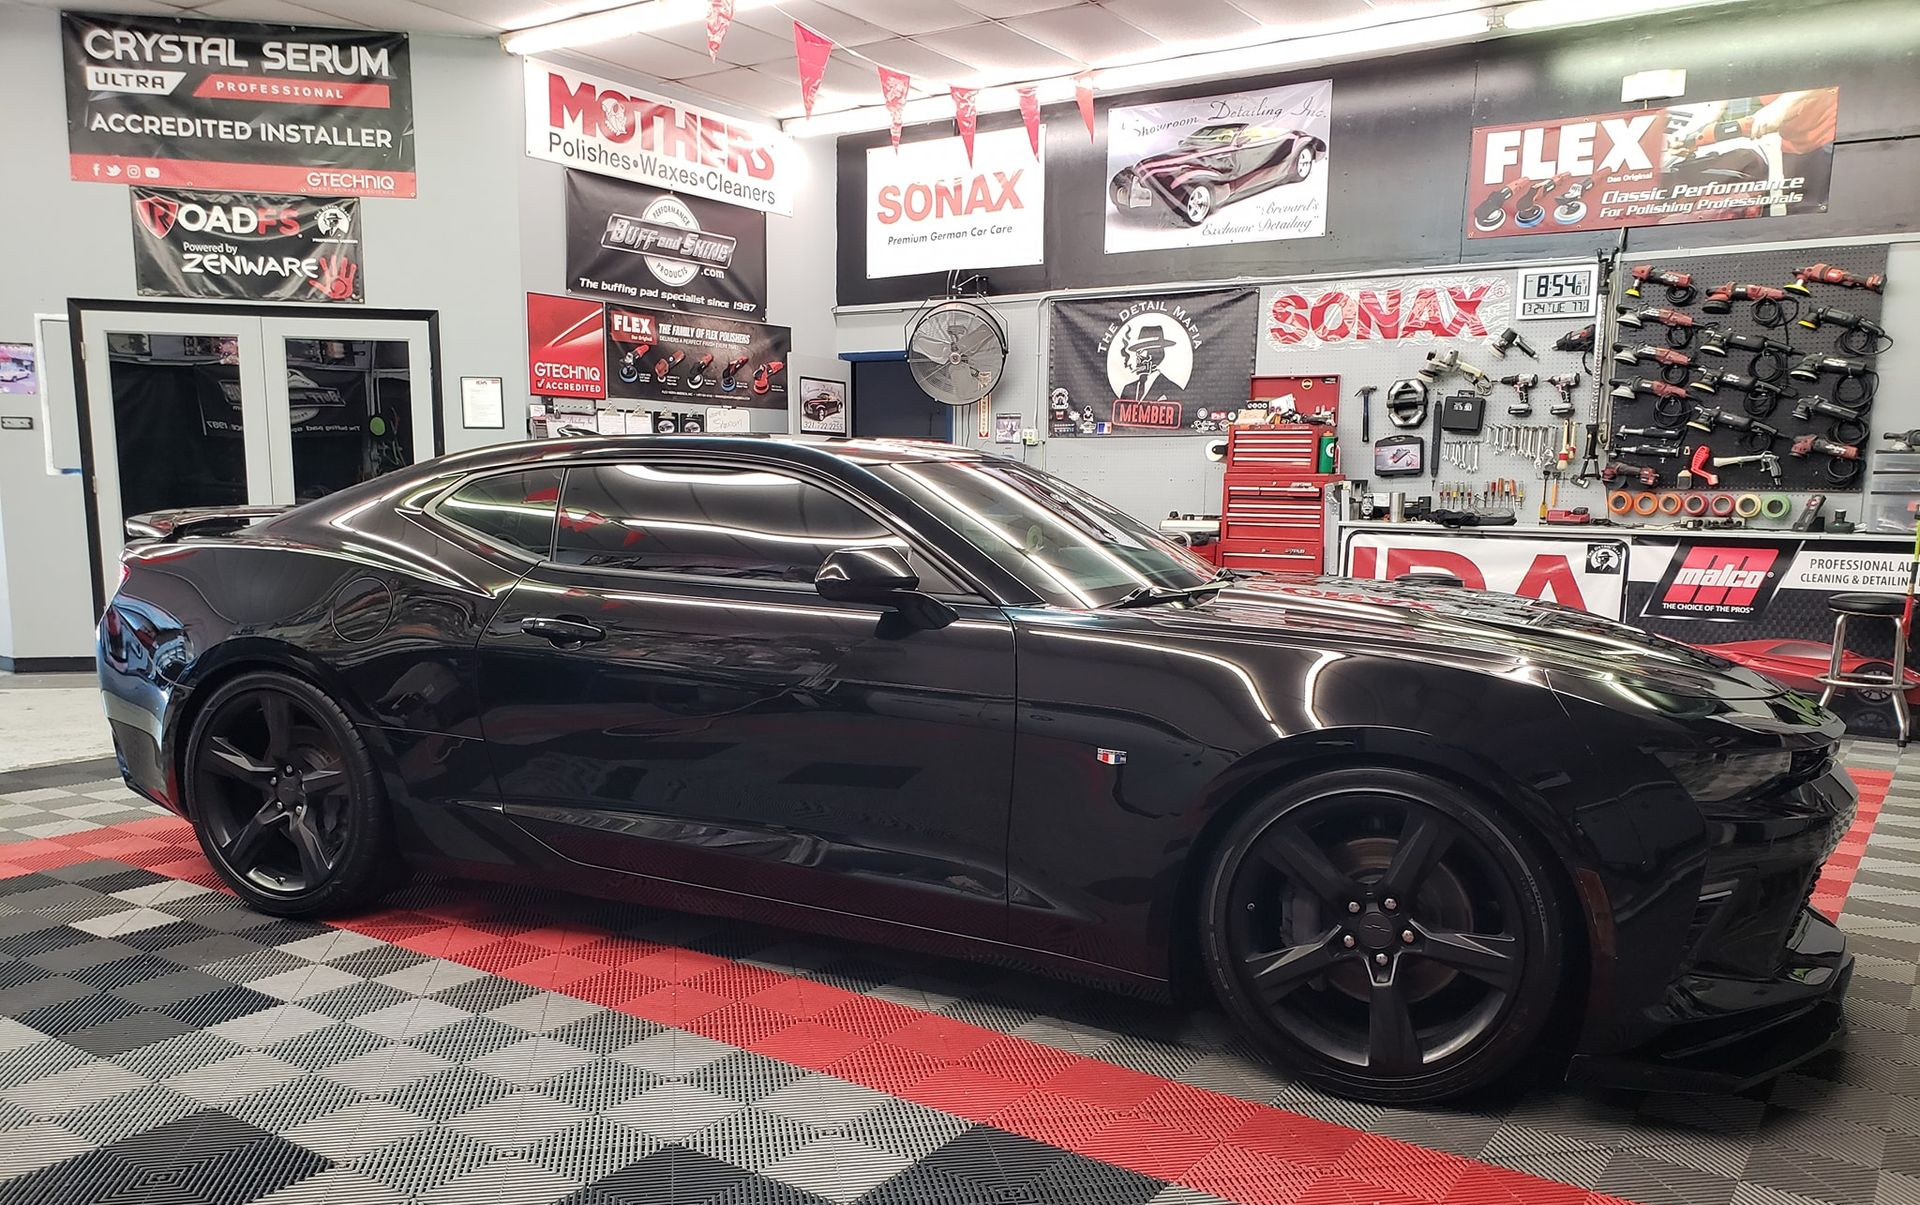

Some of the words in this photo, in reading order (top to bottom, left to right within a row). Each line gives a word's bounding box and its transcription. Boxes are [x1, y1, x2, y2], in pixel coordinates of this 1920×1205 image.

[83, 28, 249, 68] CRYSTAL
[262, 41, 391, 77] SERUM
[95, 71, 165, 89] ULTRA
[216, 81, 344, 99] PROFESSIONAL
[1208, 96, 1283, 120] Detailing
[90, 112, 252, 142] ACCREDITED
[260, 122, 393, 149] INSTALLER
[548, 72, 775, 181] MOTHERS
[1483, 113, 1660, 185] FLEX
[306, 171, 395, 190] GTECHNIQ
[1623, 172, 1653, 182] Original
[876, 168, 1025, 226] SONAX
[1601, 187, 1668, 205] Classic
[1671, 176, 1806, 200] Performance
[652, 204, 691, 227] PERFORMANCE
[1600, 206, 1624, 218] For
[1626, 201, 1697, 217] Polishing
[1697, 192, 1804, 211] Professionals
[886, 232, 928, 247] Premium
[930, 228, 968, 243] German
[970, 226, 989, 240] Car
[991, 223, 1013, 237] Care
[183, 241, 224, 253] Powered
[224, 244, 239, 255] by
[181, 253, 320, 279] ZENWARE
[655, 262, 689, 279] PRODUCTS
[700, 267, 725, 279] .com
[579, 277, 599, 290] The
[601, 280, 638, 299] buffing
[640, 286, 659, 299] pad
[660, 290, 706, 306] specialist
[706, 296, 730, 309] since
[732, 301, 757, 313] 1987
[1537, 274, 1577, 297] 8:54
[613, 313, 652, 335] FLEX
[1269, 285, 1492, 345] SONAX
[658, 323, 672, 335] THE
[671, 325, 695, 338] FAMILY
[695, 327, 705, 339] OF
[705, 329, 719, 341] FLEX
[719, 331, 751, 345] POLISHERS
[1097, 322, 1118, 354] THE
[1118, 301, 1168, 323] DETAIL
[1172, 305, 1203, 350] MAFIA
[534, 362, 601, 382] GTECHNIQ
[545, 382, 602, 393] ACCREDITED
[1119, 405, 1174, 426] MEMBER
[1674, 564, 1767, 588] malco
[1809, 558, 1895, 572] PROFESSIONAL
[1800, 573, 1850, 585] CLEANING
[1851, 575, 1860, 585] &
[1862, 575, 1909, 587] DETAILIN
[1662, 602, 1676, 611] THE
[1677, 603, 1704, 612] CHOICE
[1704, 604, 1715, 612] OF
[1716, 605, 1729, 613] THE
